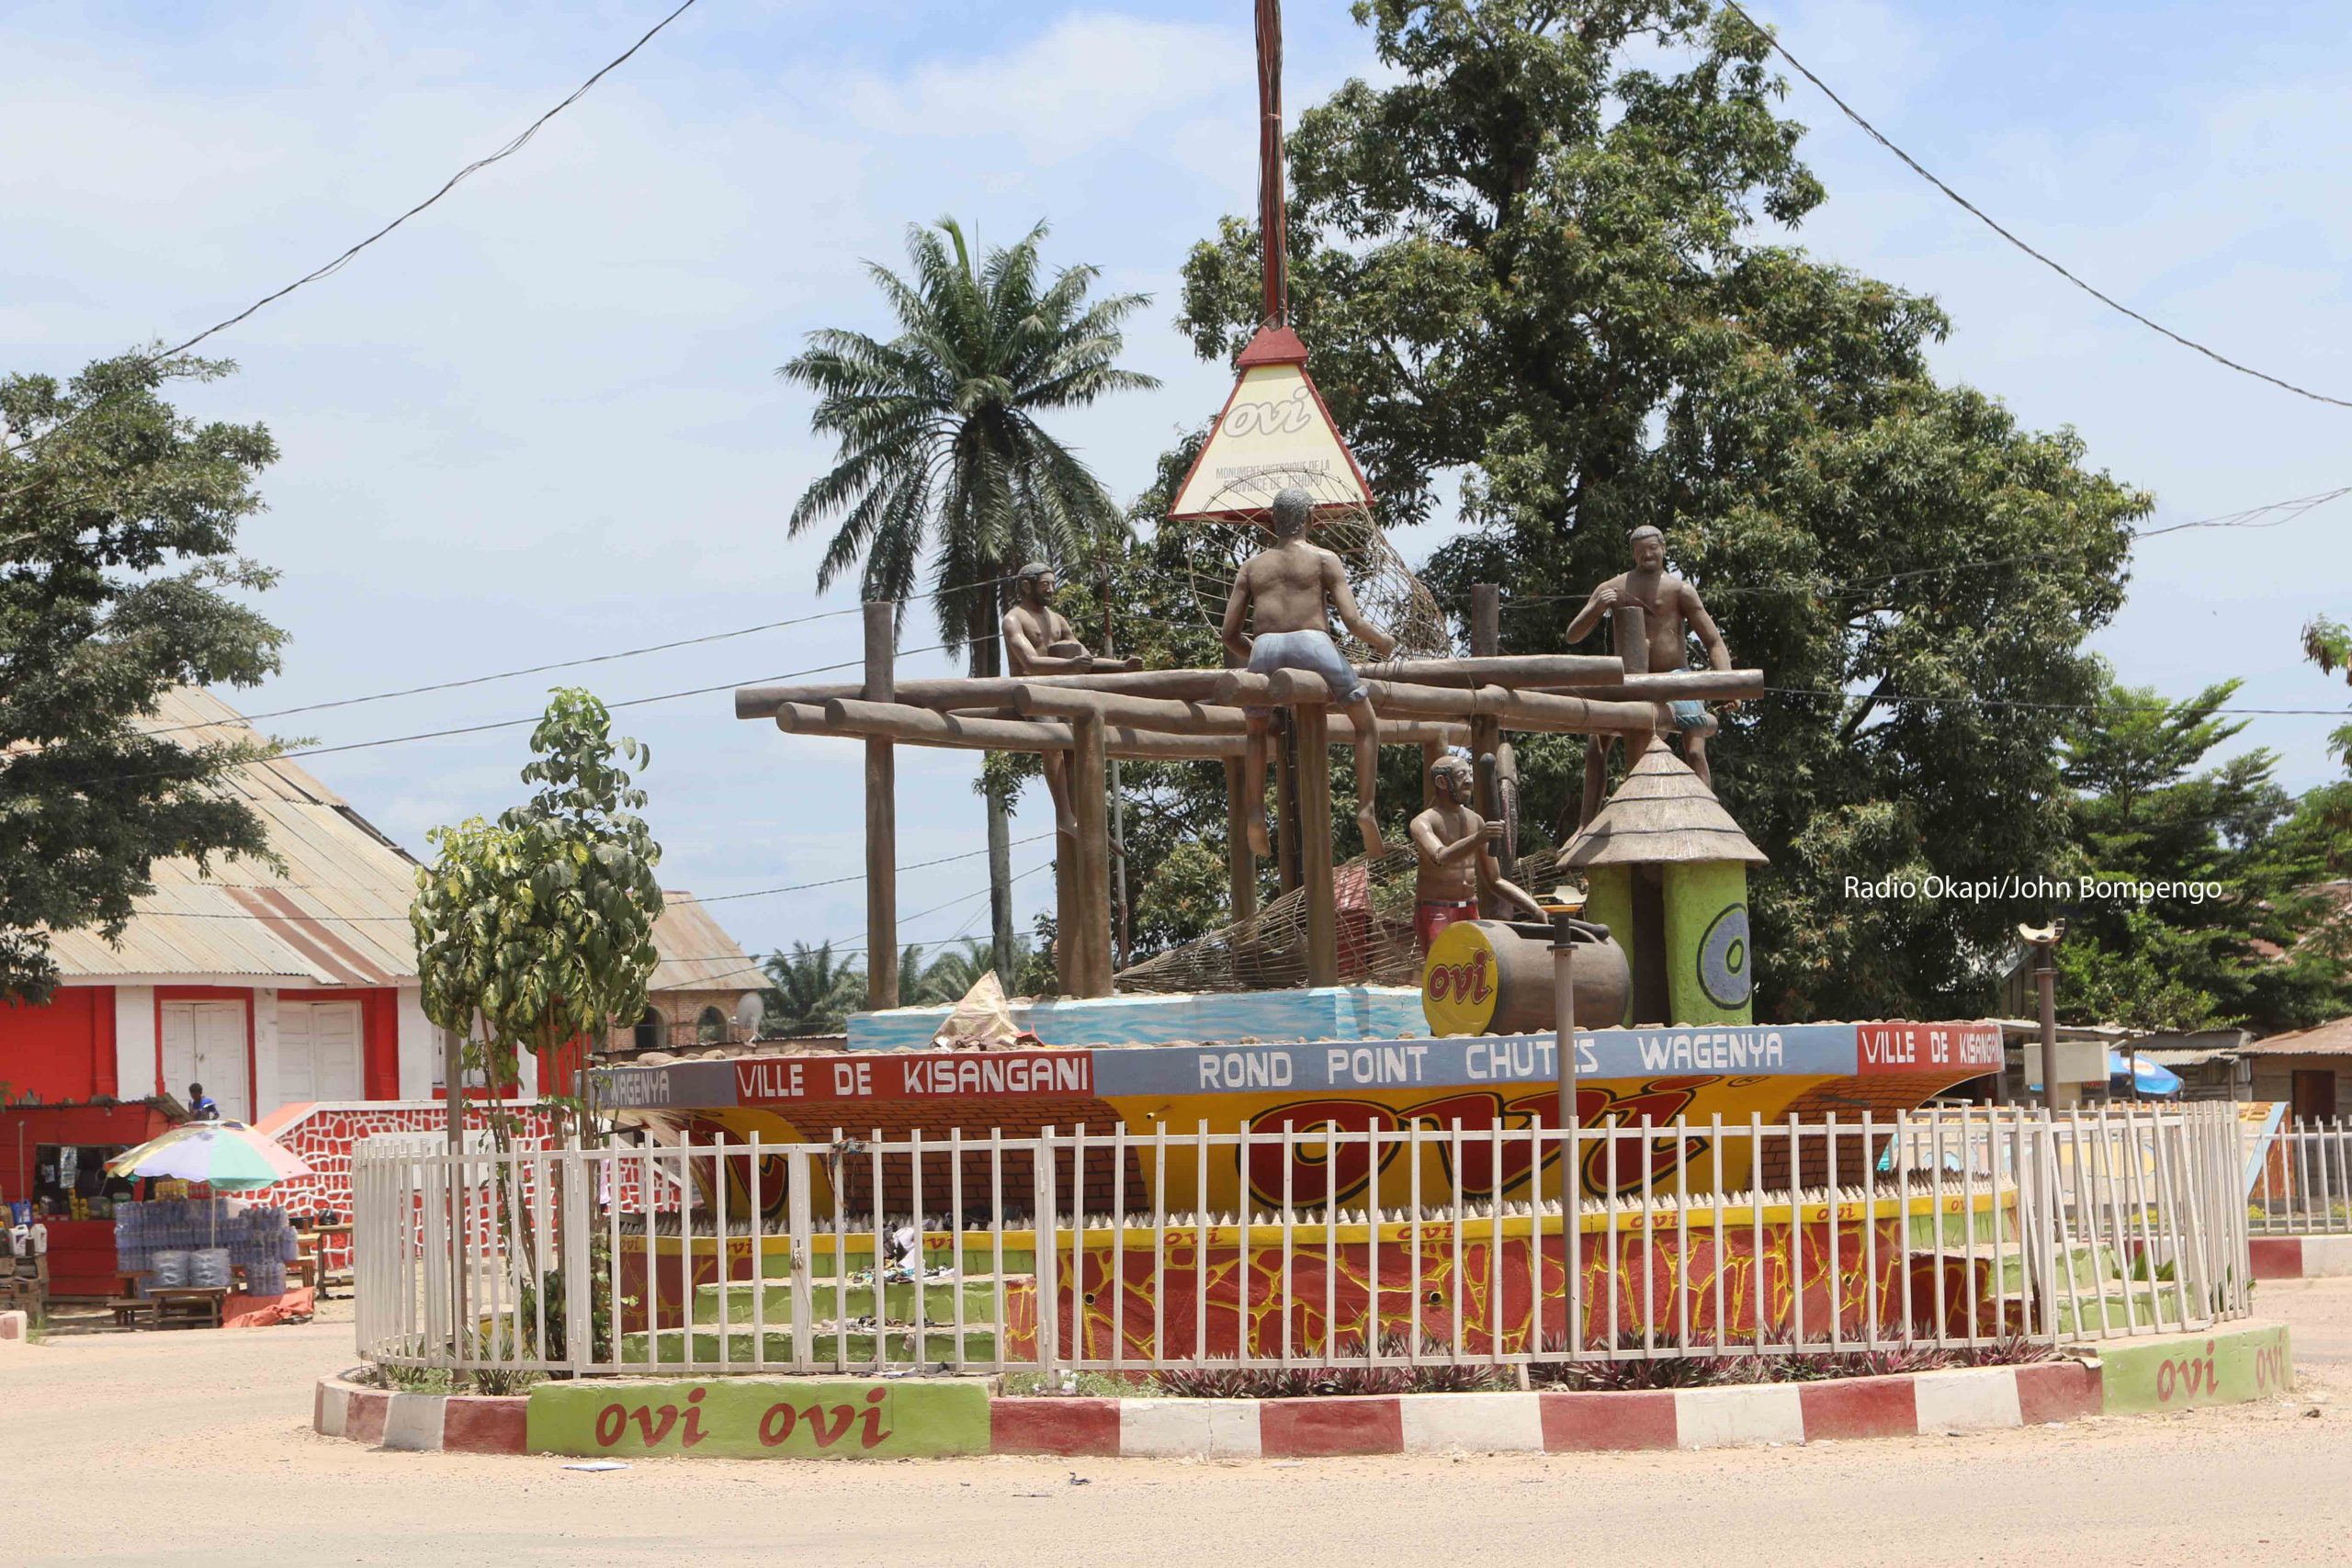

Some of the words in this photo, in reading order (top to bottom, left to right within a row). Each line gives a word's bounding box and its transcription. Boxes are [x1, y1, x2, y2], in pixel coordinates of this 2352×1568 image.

[1223, 385, 1311, 437] ovi
[1216, 465, 1261, 479] MONUMENT
[1428, 949, 1493, 1005] ovi
[1198, 1051, 1293, 1089] ROND
[1327, 1045, 1429, 1085] POINT
[1465, 1038, 1600, 1079] CHUTS
[1637, 1032, 1783, 1070] WAGENYA
[1861, 1031, 1916, 1064] VILLE
[1929, 1031, 1949, 1063] DE
[609, 1069, 670, 1106] WAGENYA
[737, 1064, 805, 1098] VILLE
[833, 1062, 872, 1096] DE
[903, 1057, 1088, 1093] KISANGANI
[2156, 1339, 2220, 1402] ovi
[2256, 1327, 2284, 1392] ovi
[595, 1387, 711, 1449] ovi
[758, 1386, 894, 1450] ovi
